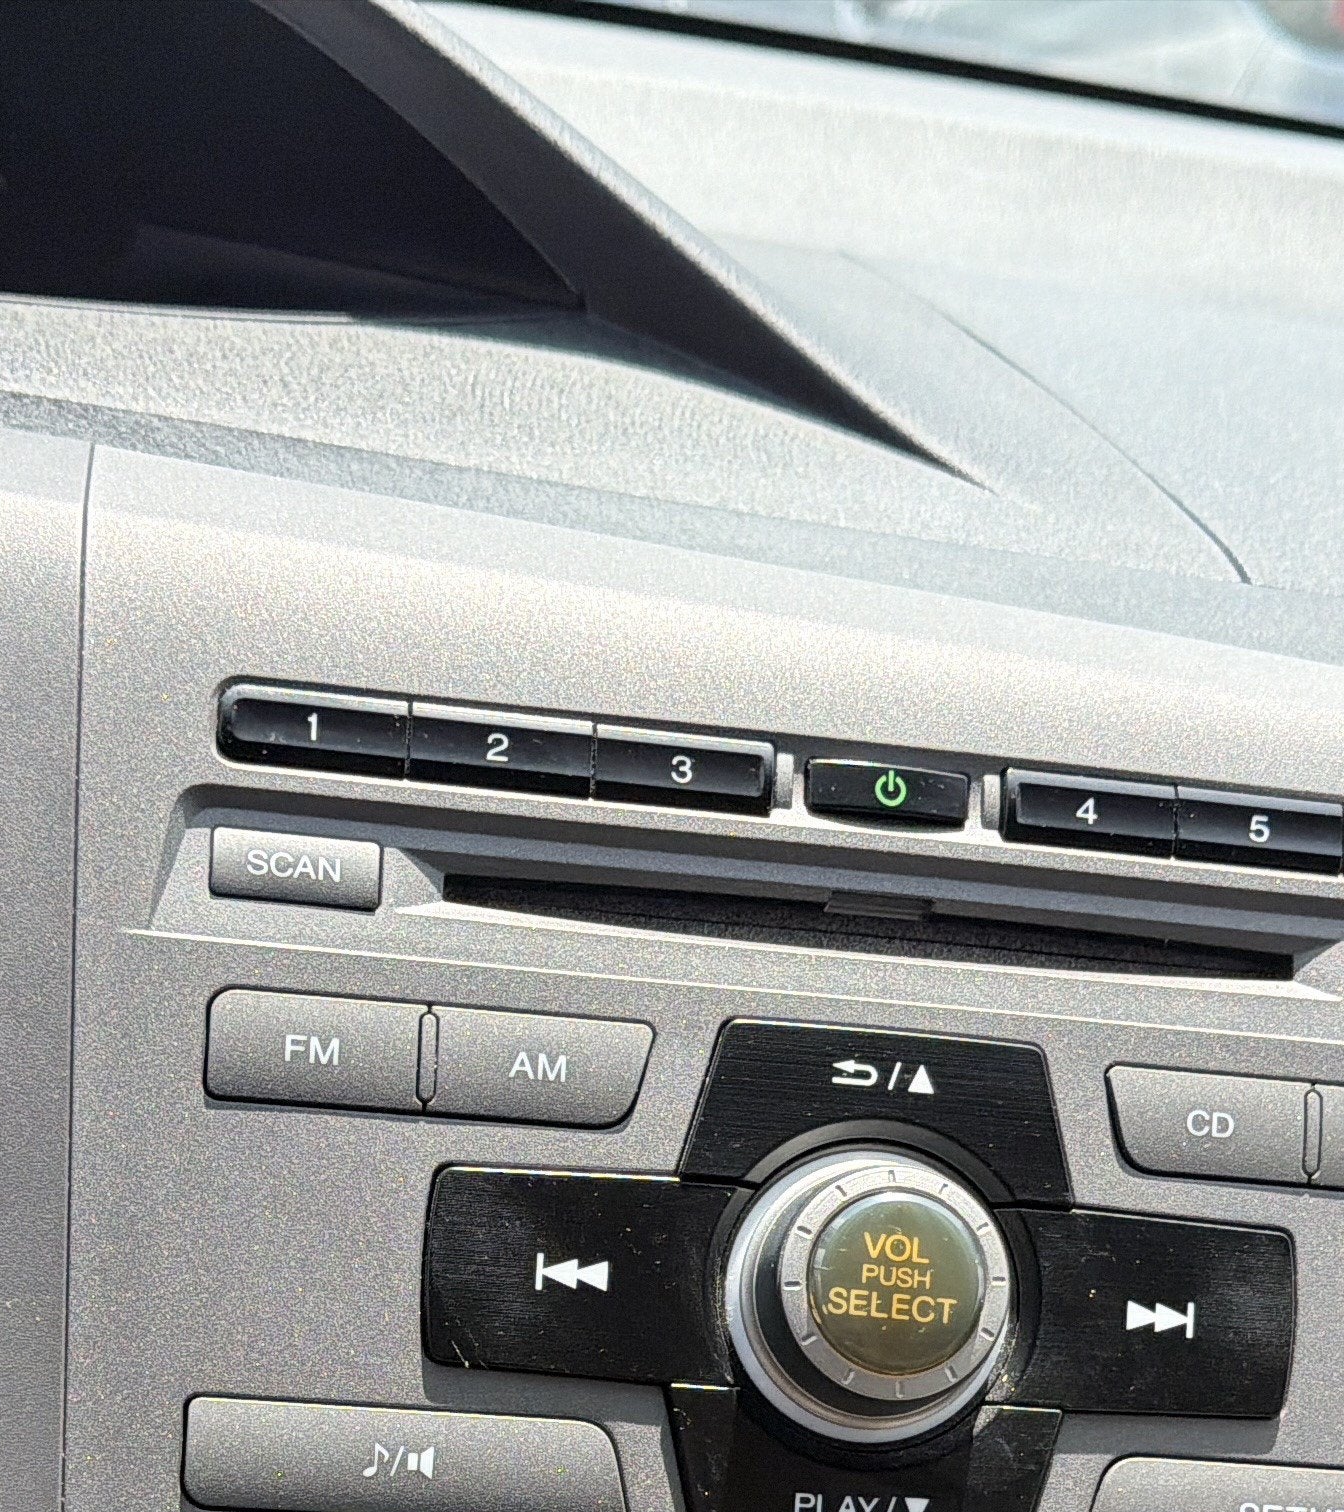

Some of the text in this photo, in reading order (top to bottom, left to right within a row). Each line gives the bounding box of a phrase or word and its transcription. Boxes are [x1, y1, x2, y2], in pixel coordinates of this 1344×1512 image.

[305, 711, 319, 742] 1
[485, 731, 511, 763] 2
[669, 754, 694, 785] 3
[1074, 796, 1099, 826] 4
[1247, 814, 1271, 844] 5
[245, 848, 342, 884] SCAN
[283, 1033, 341, 1067] FM
[507, 1050, 568, 1084] AM
[1185, 1108, 1236, 1139] CD
[863, 1231, 930, 1264] VOL
[860, 1263, 932, 1290] PUSH
[827, 1286, 958, 1325] SELECT
